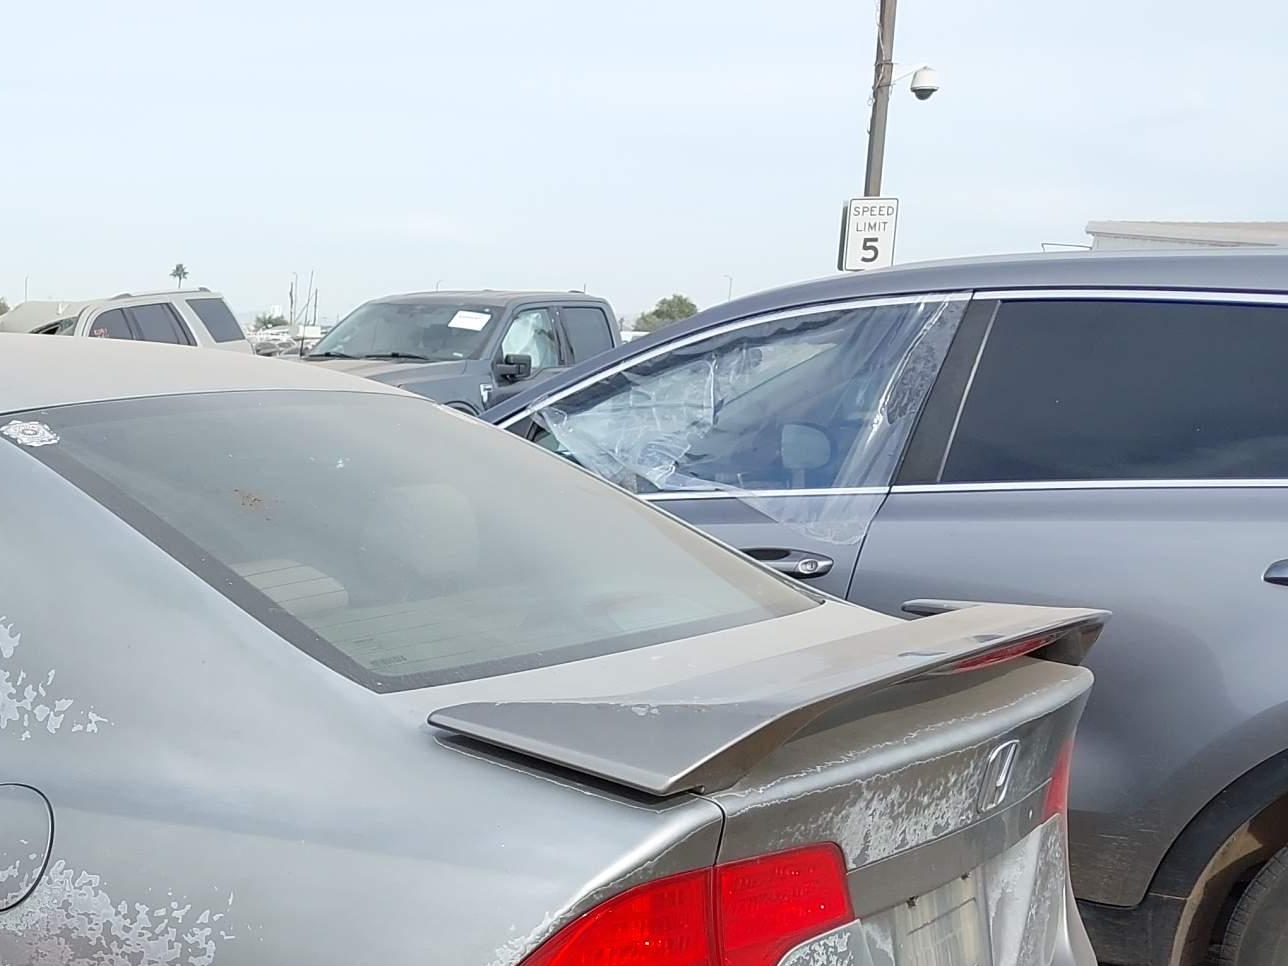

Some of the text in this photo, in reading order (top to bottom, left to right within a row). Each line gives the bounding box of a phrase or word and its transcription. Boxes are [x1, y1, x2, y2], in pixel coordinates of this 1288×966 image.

[852, 206, 895, 217] SPEED
[855, 221, 889, 232] LIMIT
[860, 237, 879, 263] 5
